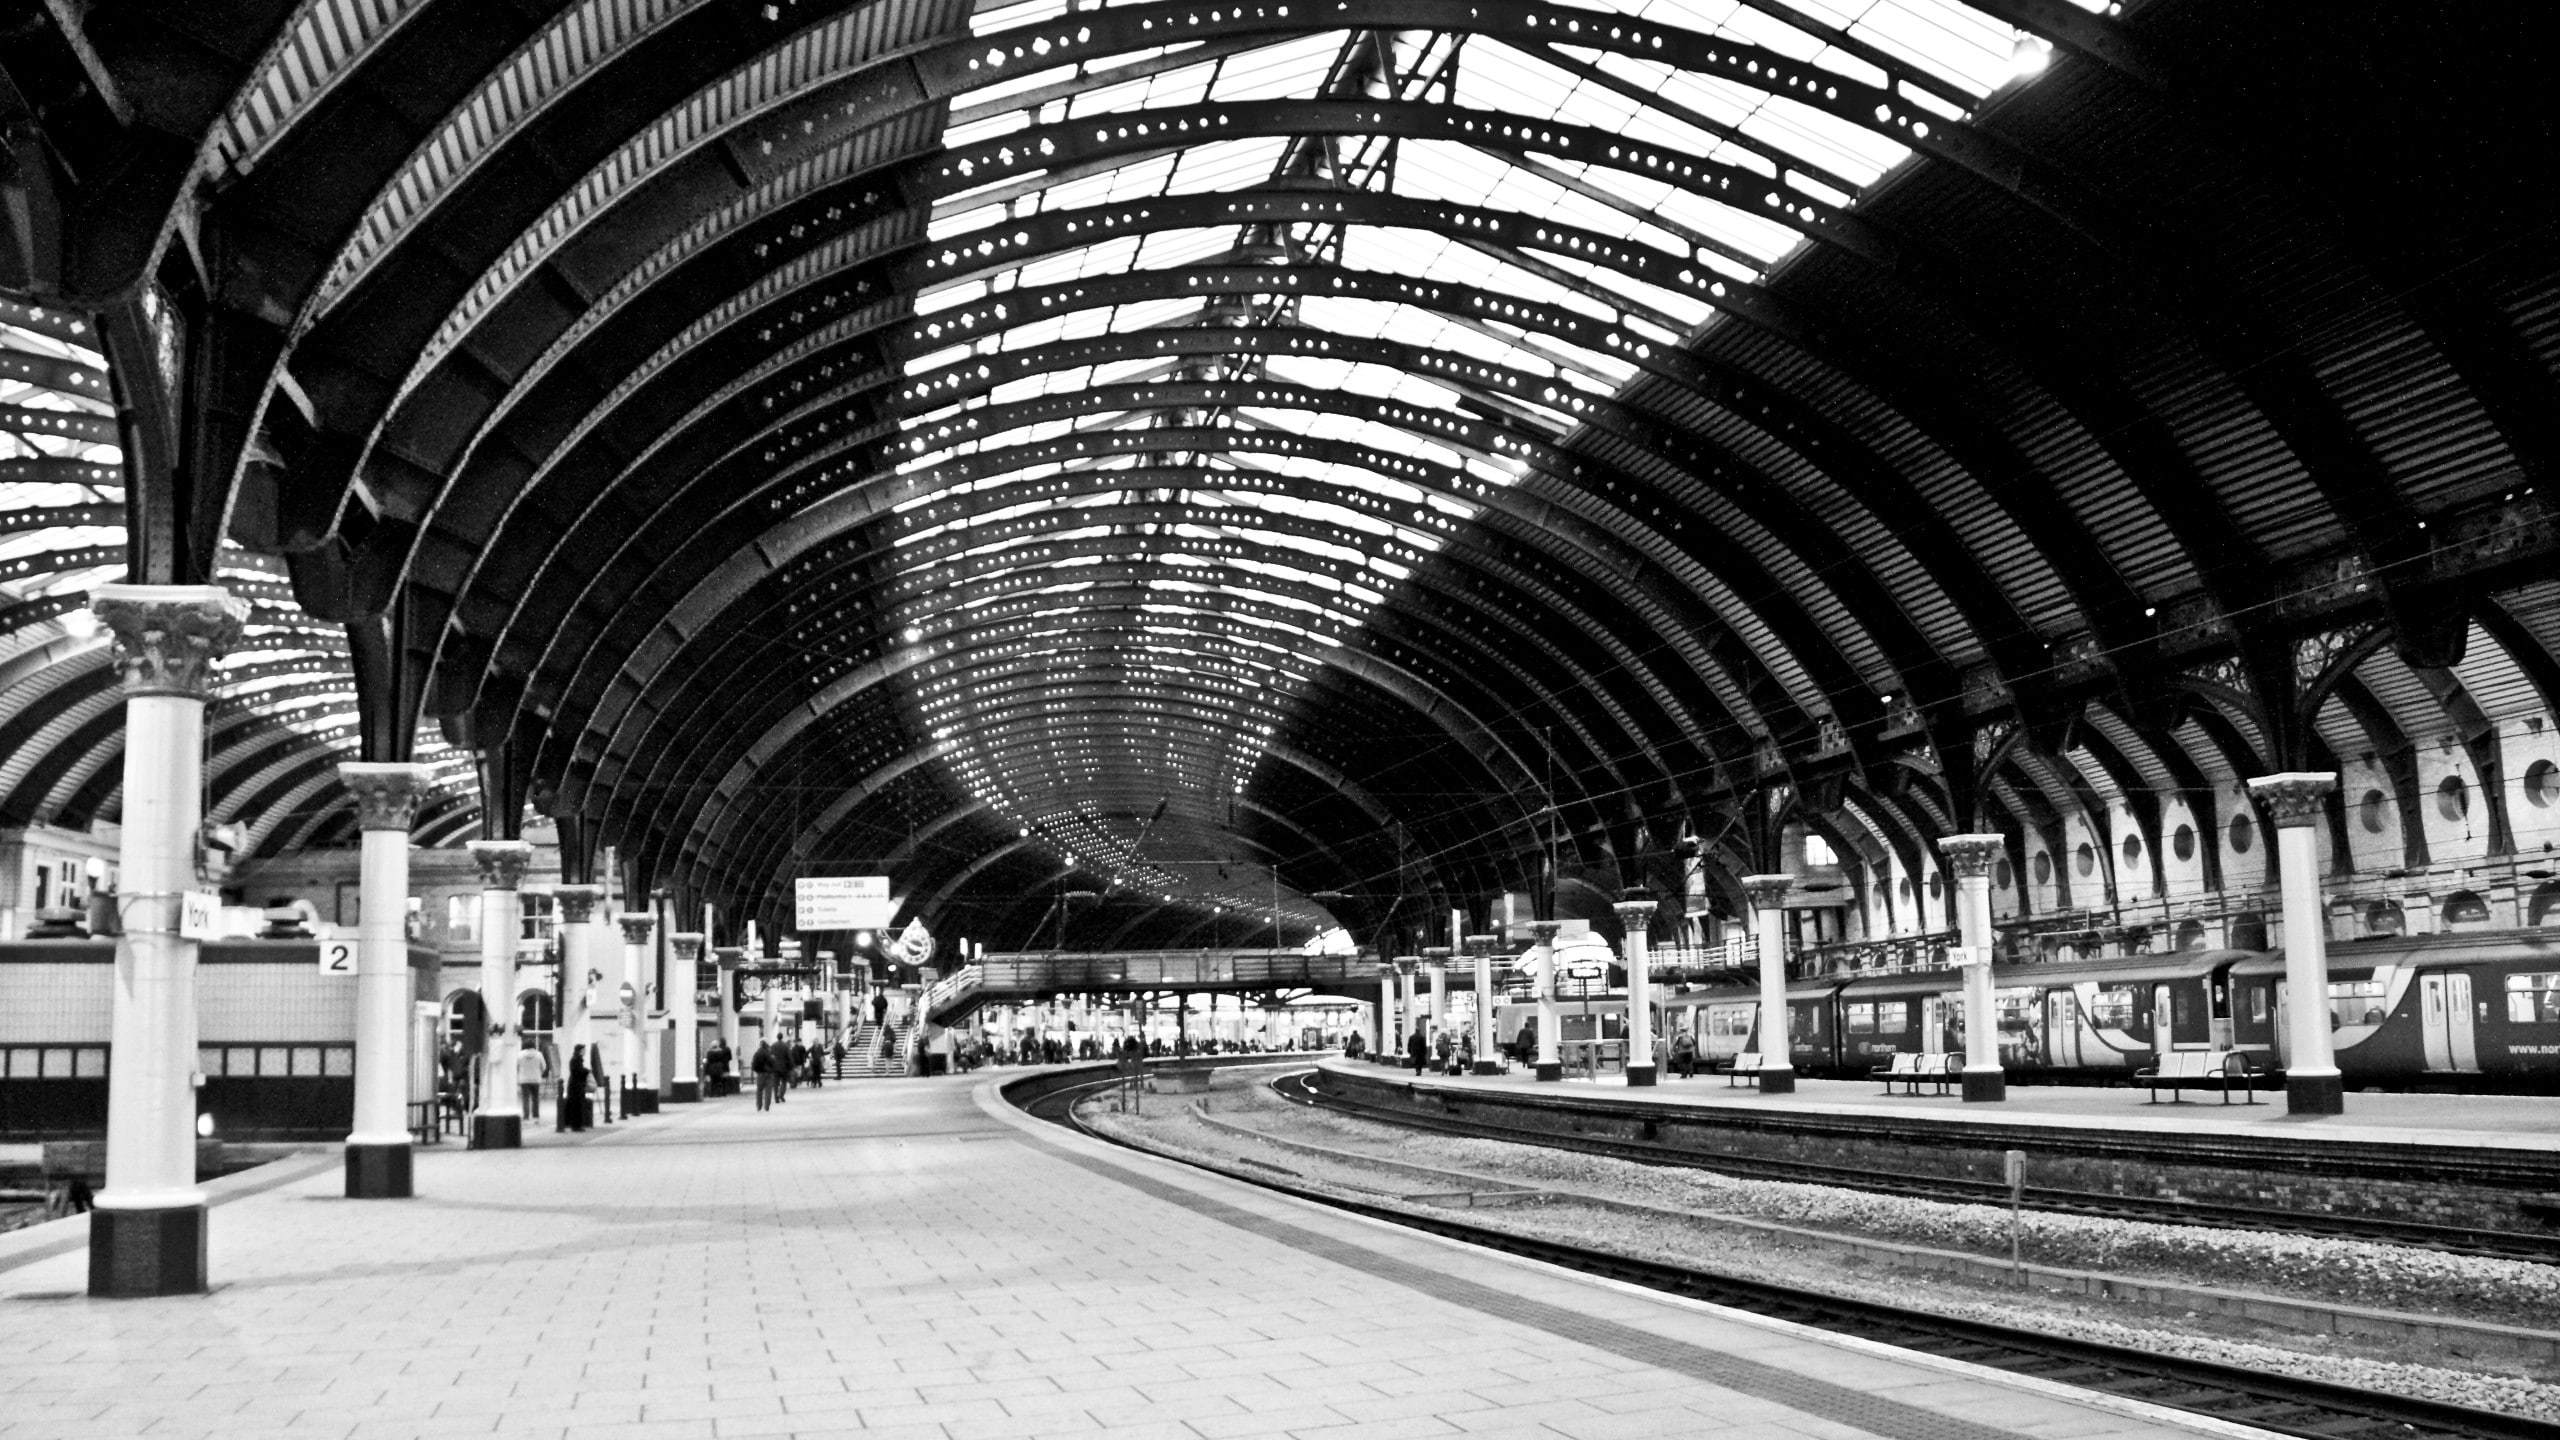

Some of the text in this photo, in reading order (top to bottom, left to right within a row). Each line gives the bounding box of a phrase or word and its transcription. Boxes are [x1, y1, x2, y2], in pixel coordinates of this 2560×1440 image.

[187, 900, 210, 929] York
[330, 945, 349, 970] 2
[1952, 951, 1967, 961] York
